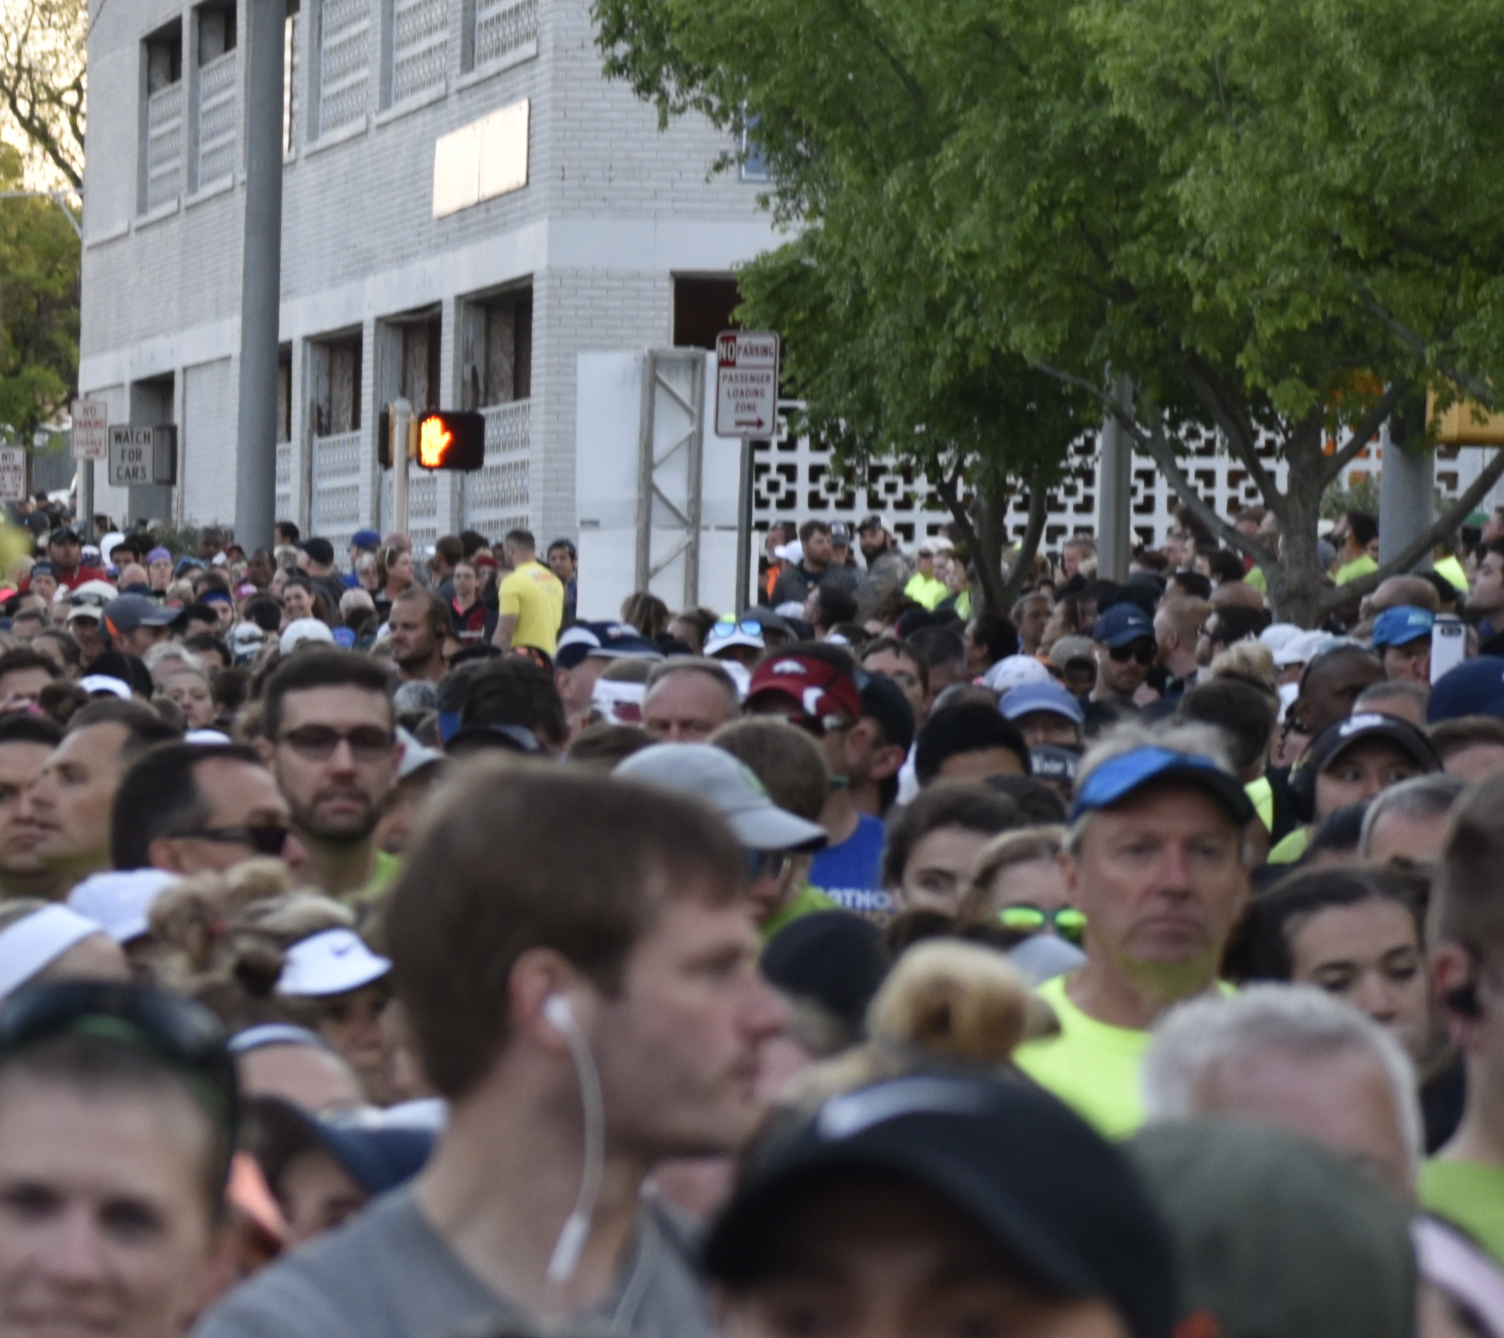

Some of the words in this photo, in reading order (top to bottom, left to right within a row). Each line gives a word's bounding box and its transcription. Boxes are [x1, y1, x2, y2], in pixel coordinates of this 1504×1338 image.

[719, 342, 736, 362] NO
[737, 344, 774, 357] PARKING
[722, 374, 771, 384] PASSENGER
[727, 388, 765, 399] LOADING
[734, 403, 757, 414] ZONE
[114, 429, 151, 444] WATCH
[1, 452, 15, 461] NO
[121, 448, 143, 461] FOR
[116, 464, 147, 480] CARS
